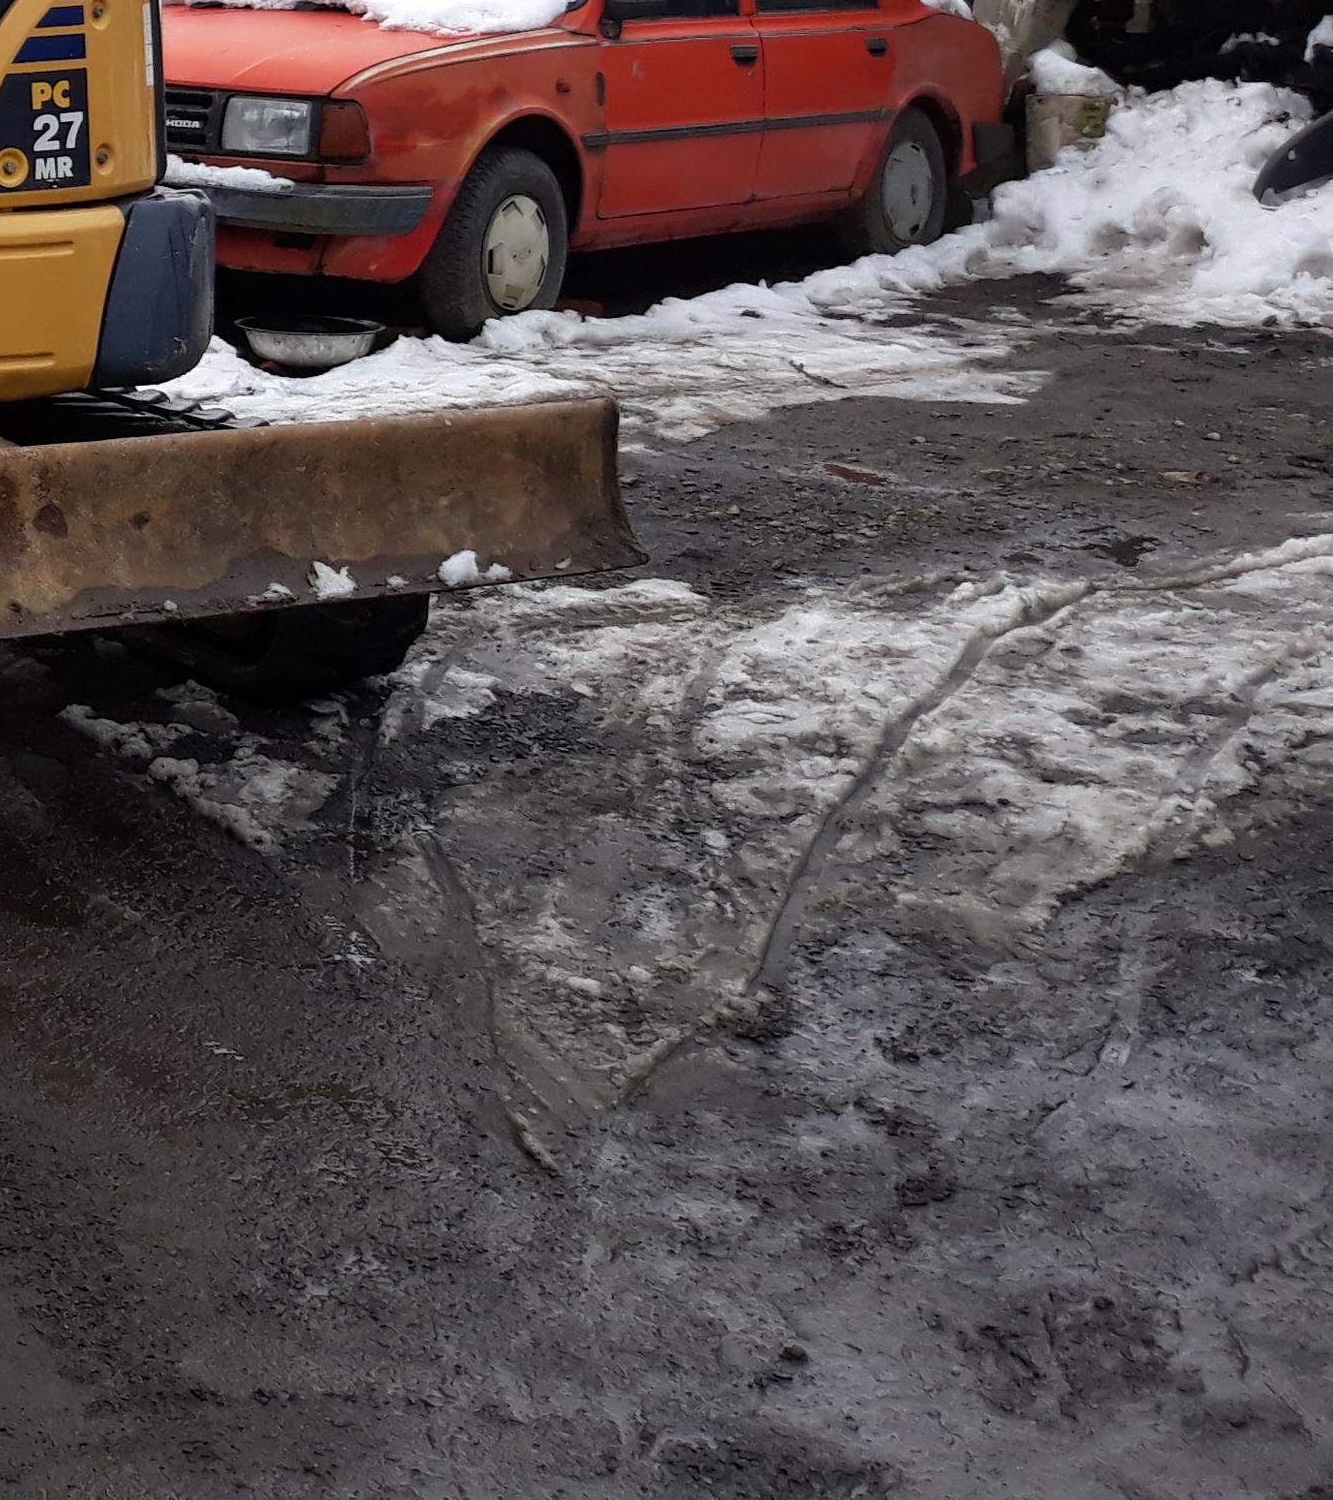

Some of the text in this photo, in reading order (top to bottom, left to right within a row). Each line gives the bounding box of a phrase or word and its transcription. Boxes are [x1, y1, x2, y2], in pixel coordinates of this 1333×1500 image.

[31, 80, 70, 110] PC
[33, 111, 83, 152] 27
[165, 118, 201, 129] KODA
[34, 156, 73, 181] MR
